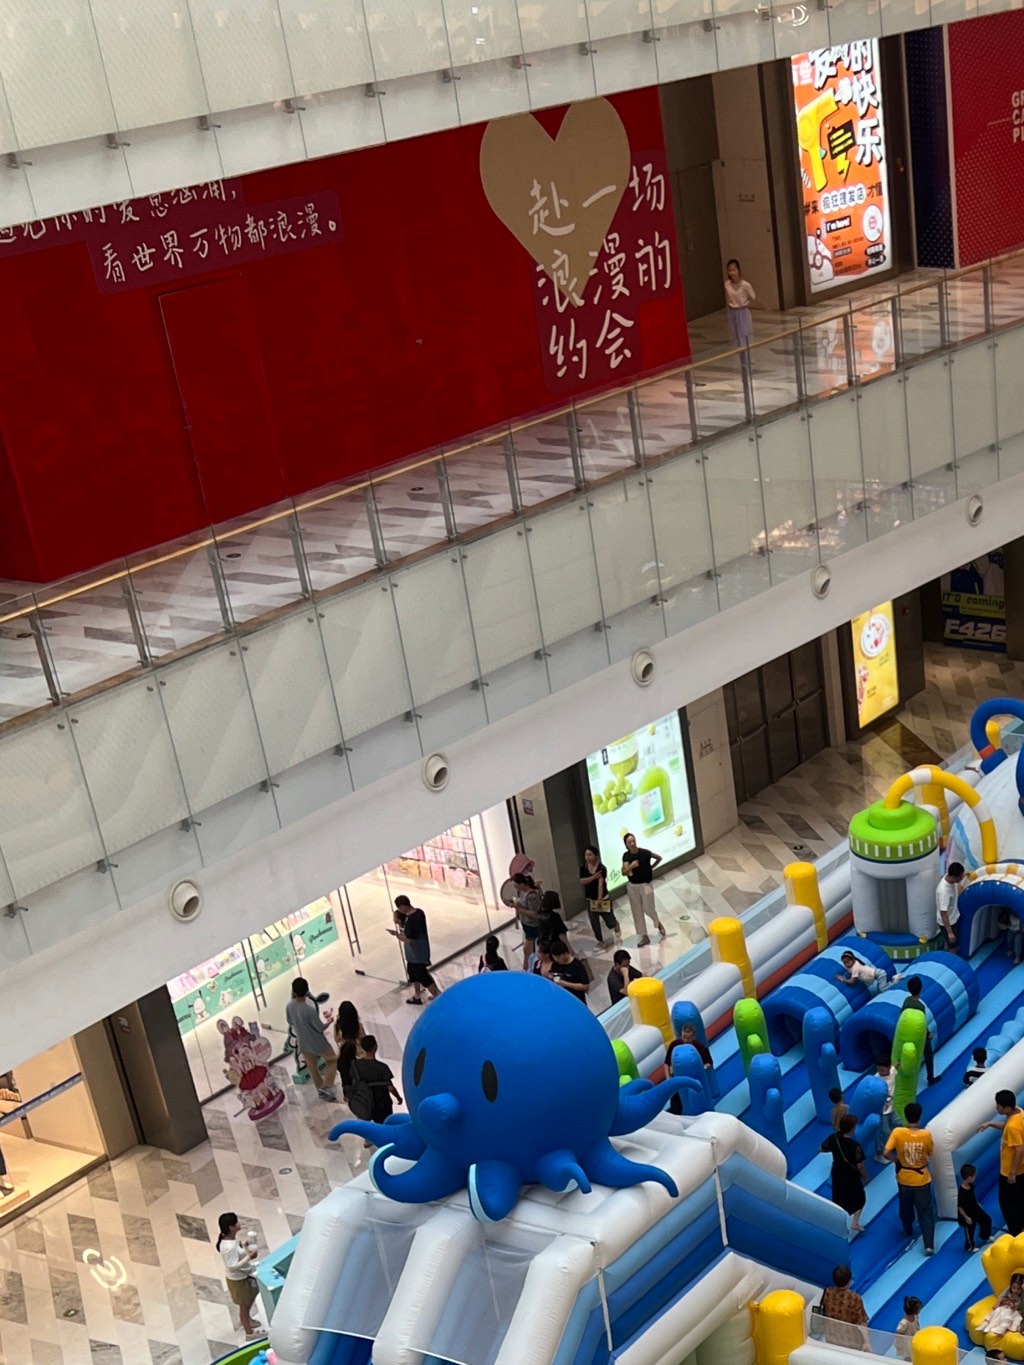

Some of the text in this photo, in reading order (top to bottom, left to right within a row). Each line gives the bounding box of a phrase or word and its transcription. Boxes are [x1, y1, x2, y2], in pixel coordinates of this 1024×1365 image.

[529, 163, 665, 235] 赴一场
[102, 203, 337, 283] 看世界万物都浪漫。
[549, 309, 635, 380] 约会
[966, 596, 1006, 609] coming
